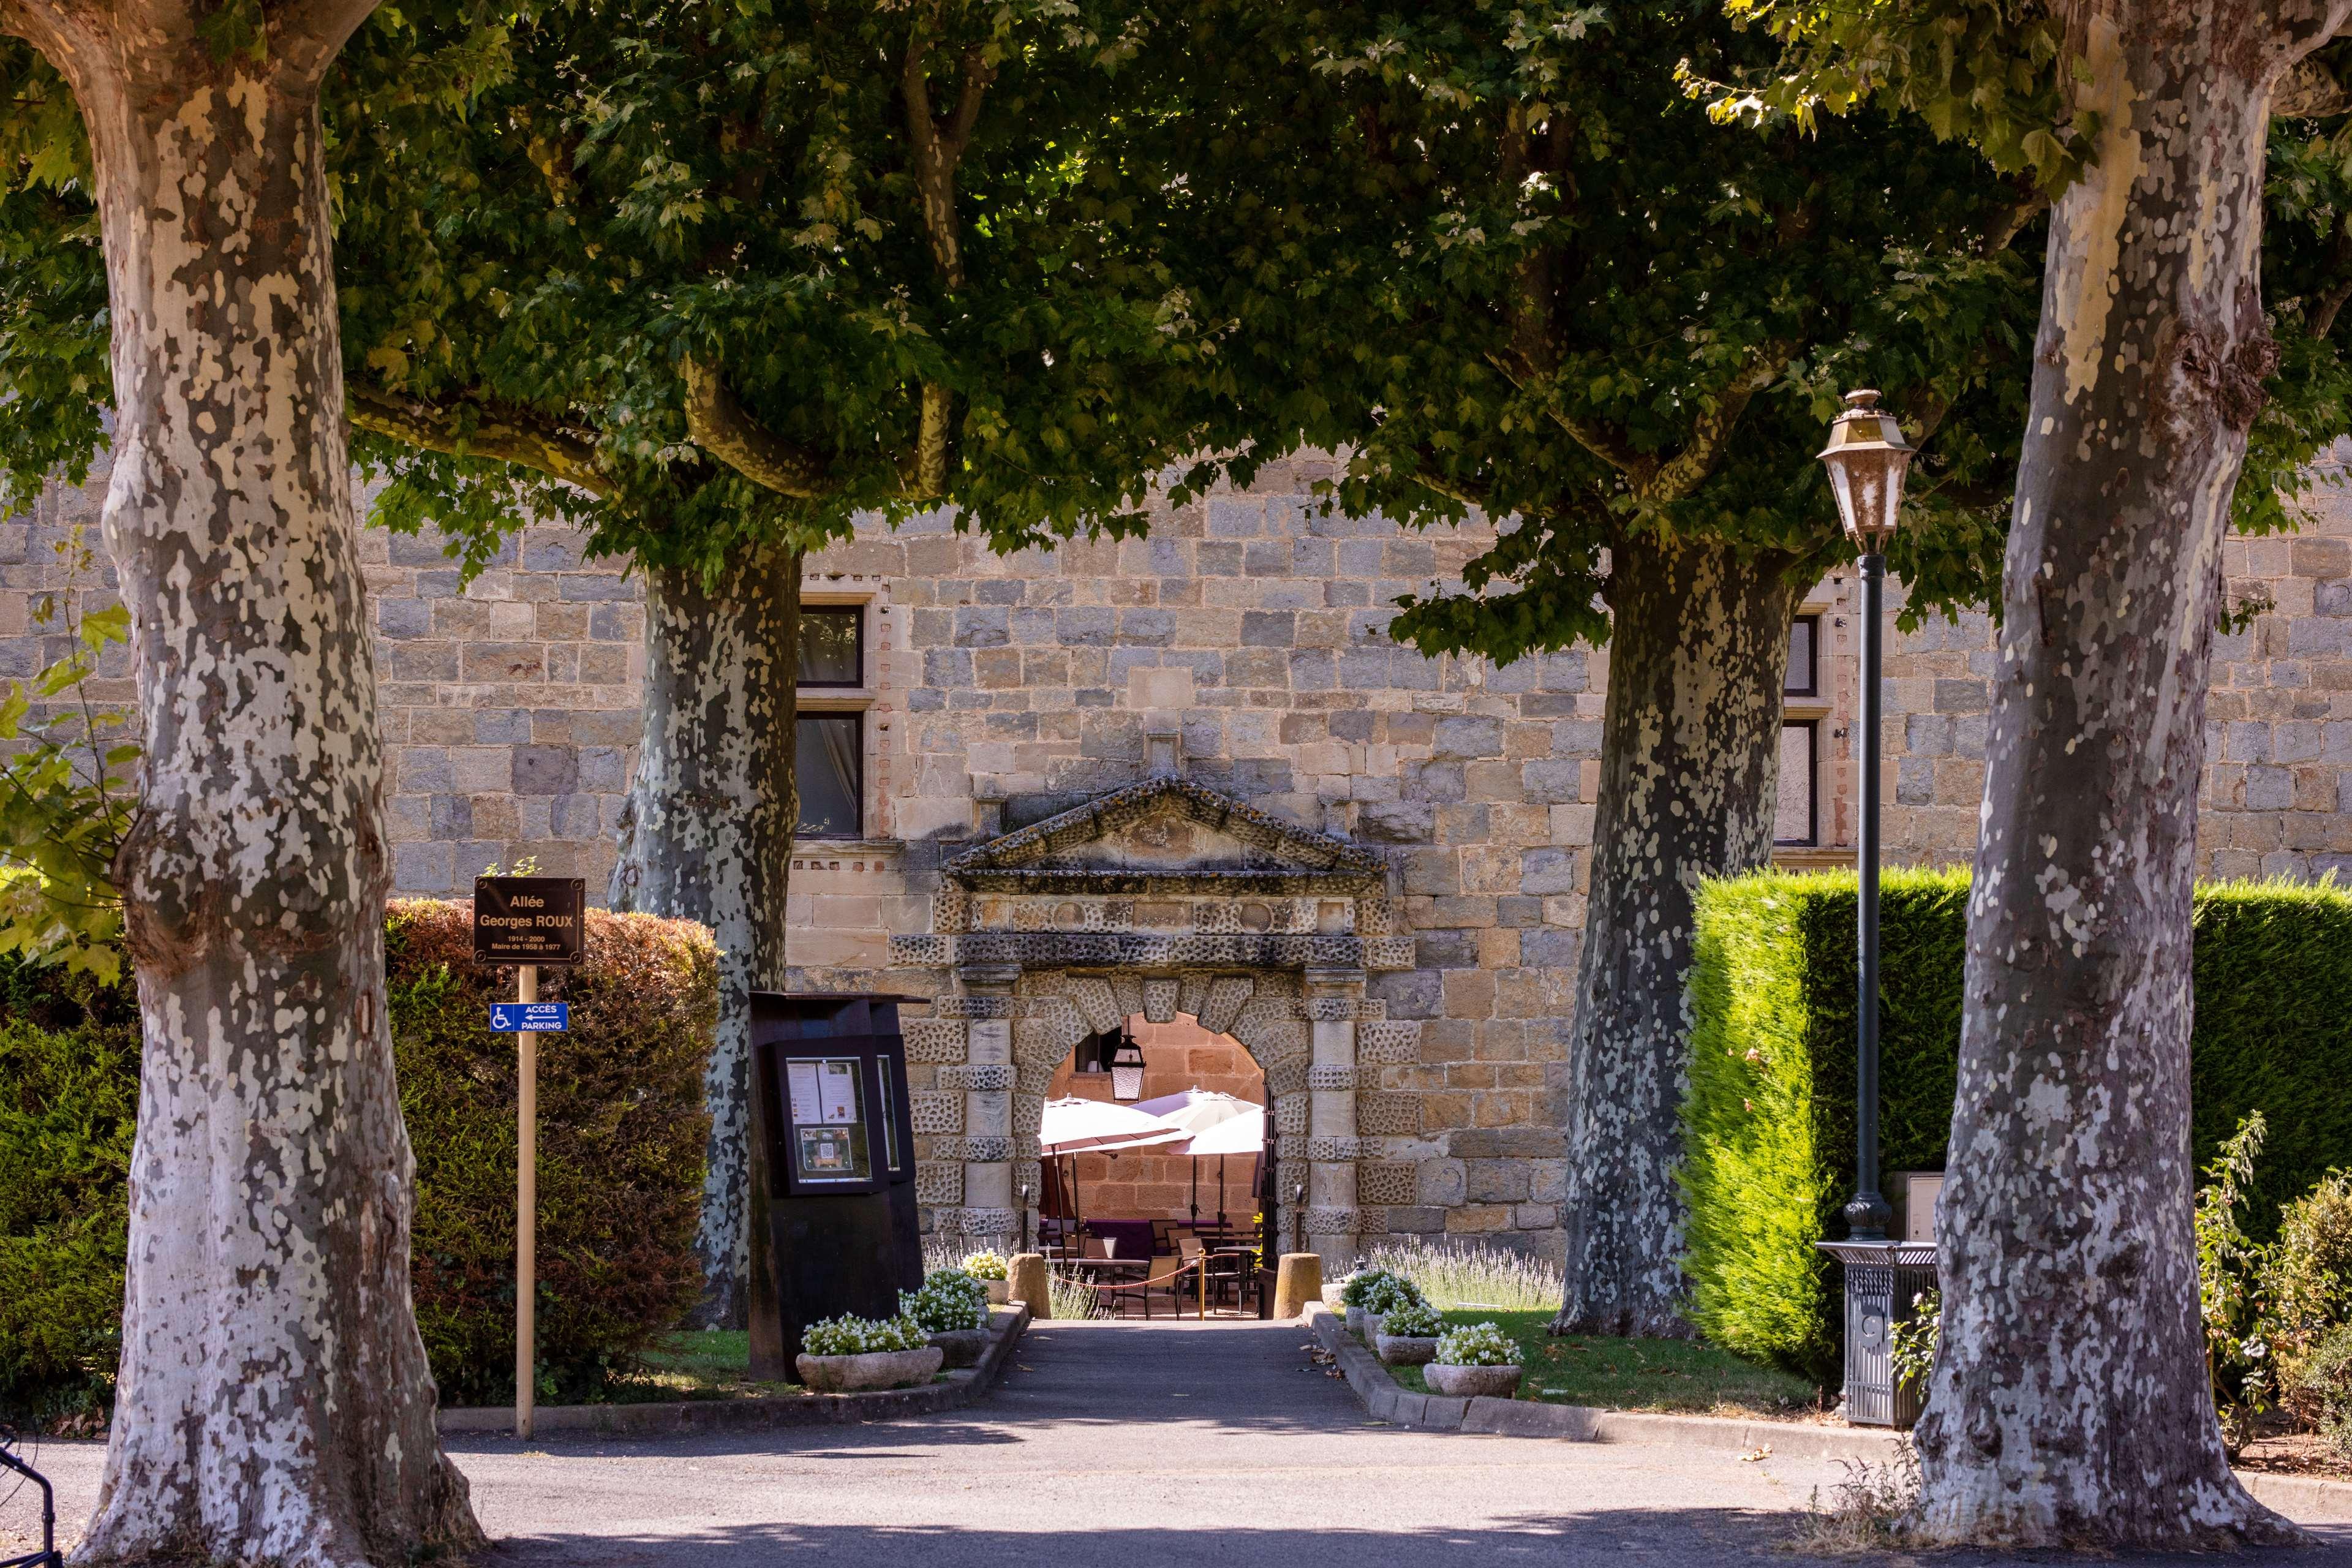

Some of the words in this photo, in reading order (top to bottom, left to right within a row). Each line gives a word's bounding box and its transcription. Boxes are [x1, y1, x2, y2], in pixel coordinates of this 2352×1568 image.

[510, 895, 545, 908] Allée
[480, 914, 533, 930] Georges
[536, 915, 573, 927] ROUX
[525, 1005, 557, 1014] ACCÈS
